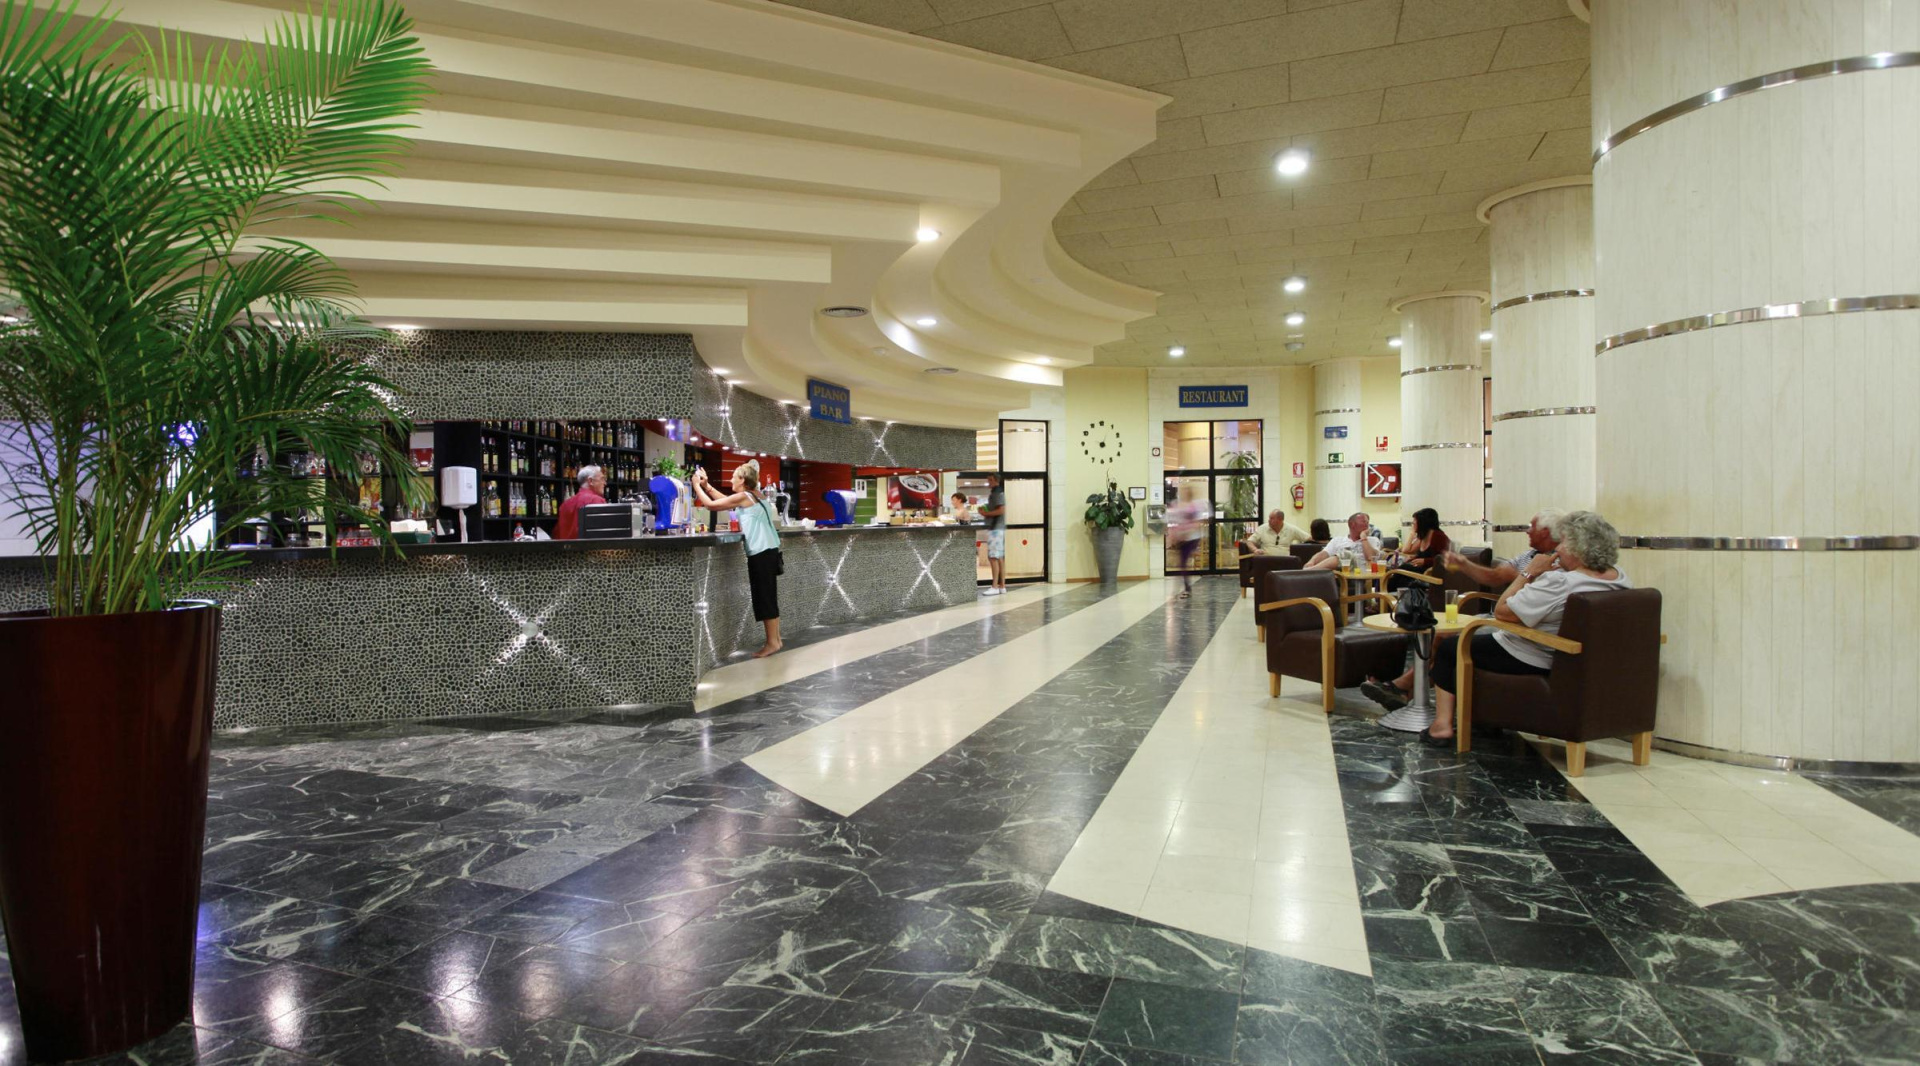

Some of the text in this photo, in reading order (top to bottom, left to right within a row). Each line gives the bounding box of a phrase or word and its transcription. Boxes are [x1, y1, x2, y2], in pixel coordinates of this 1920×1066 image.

[813, 385, 847, 402] PIANO
[1182, 390, 1245, 403] RESTAURANT
[820, 404, 843, 419] BAR
